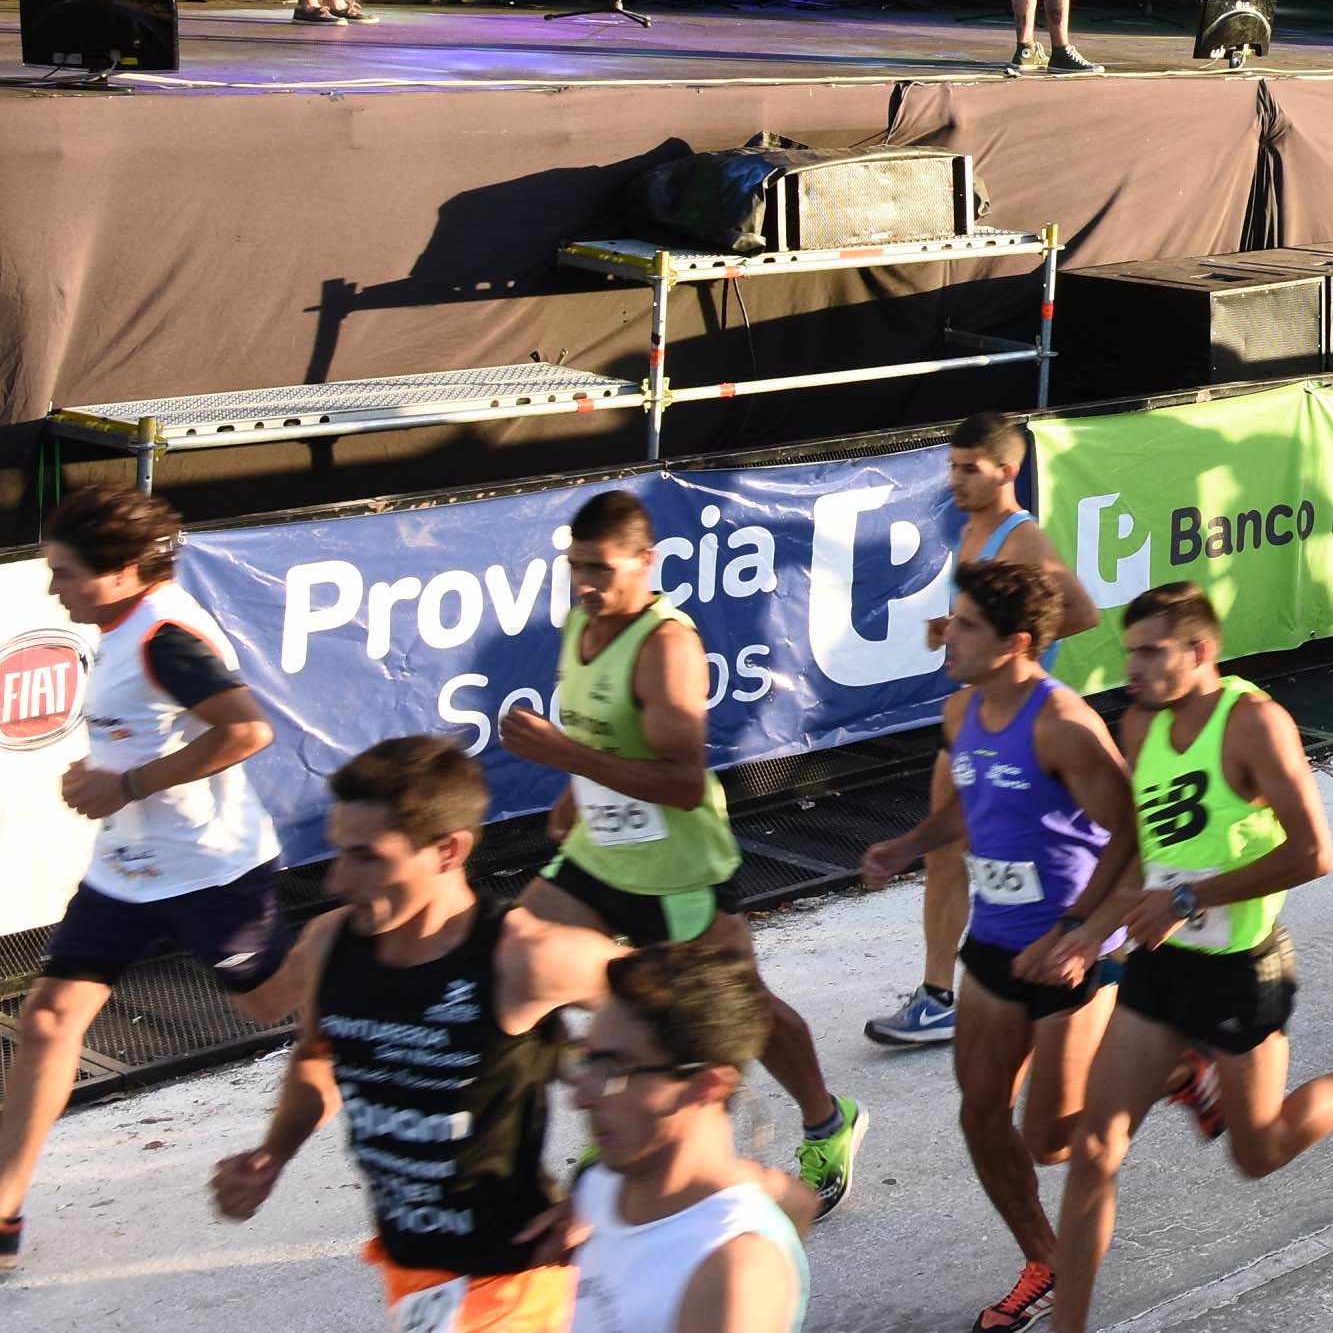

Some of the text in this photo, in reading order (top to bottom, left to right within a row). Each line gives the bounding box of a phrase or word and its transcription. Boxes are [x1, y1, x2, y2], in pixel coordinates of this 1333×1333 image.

[1169, 496, 1315, 567] Banco
[282, 505, 778, 673] Provicia
[3, 661, 71, 723] FIAT
[436, 644, 773, 757] Seos
